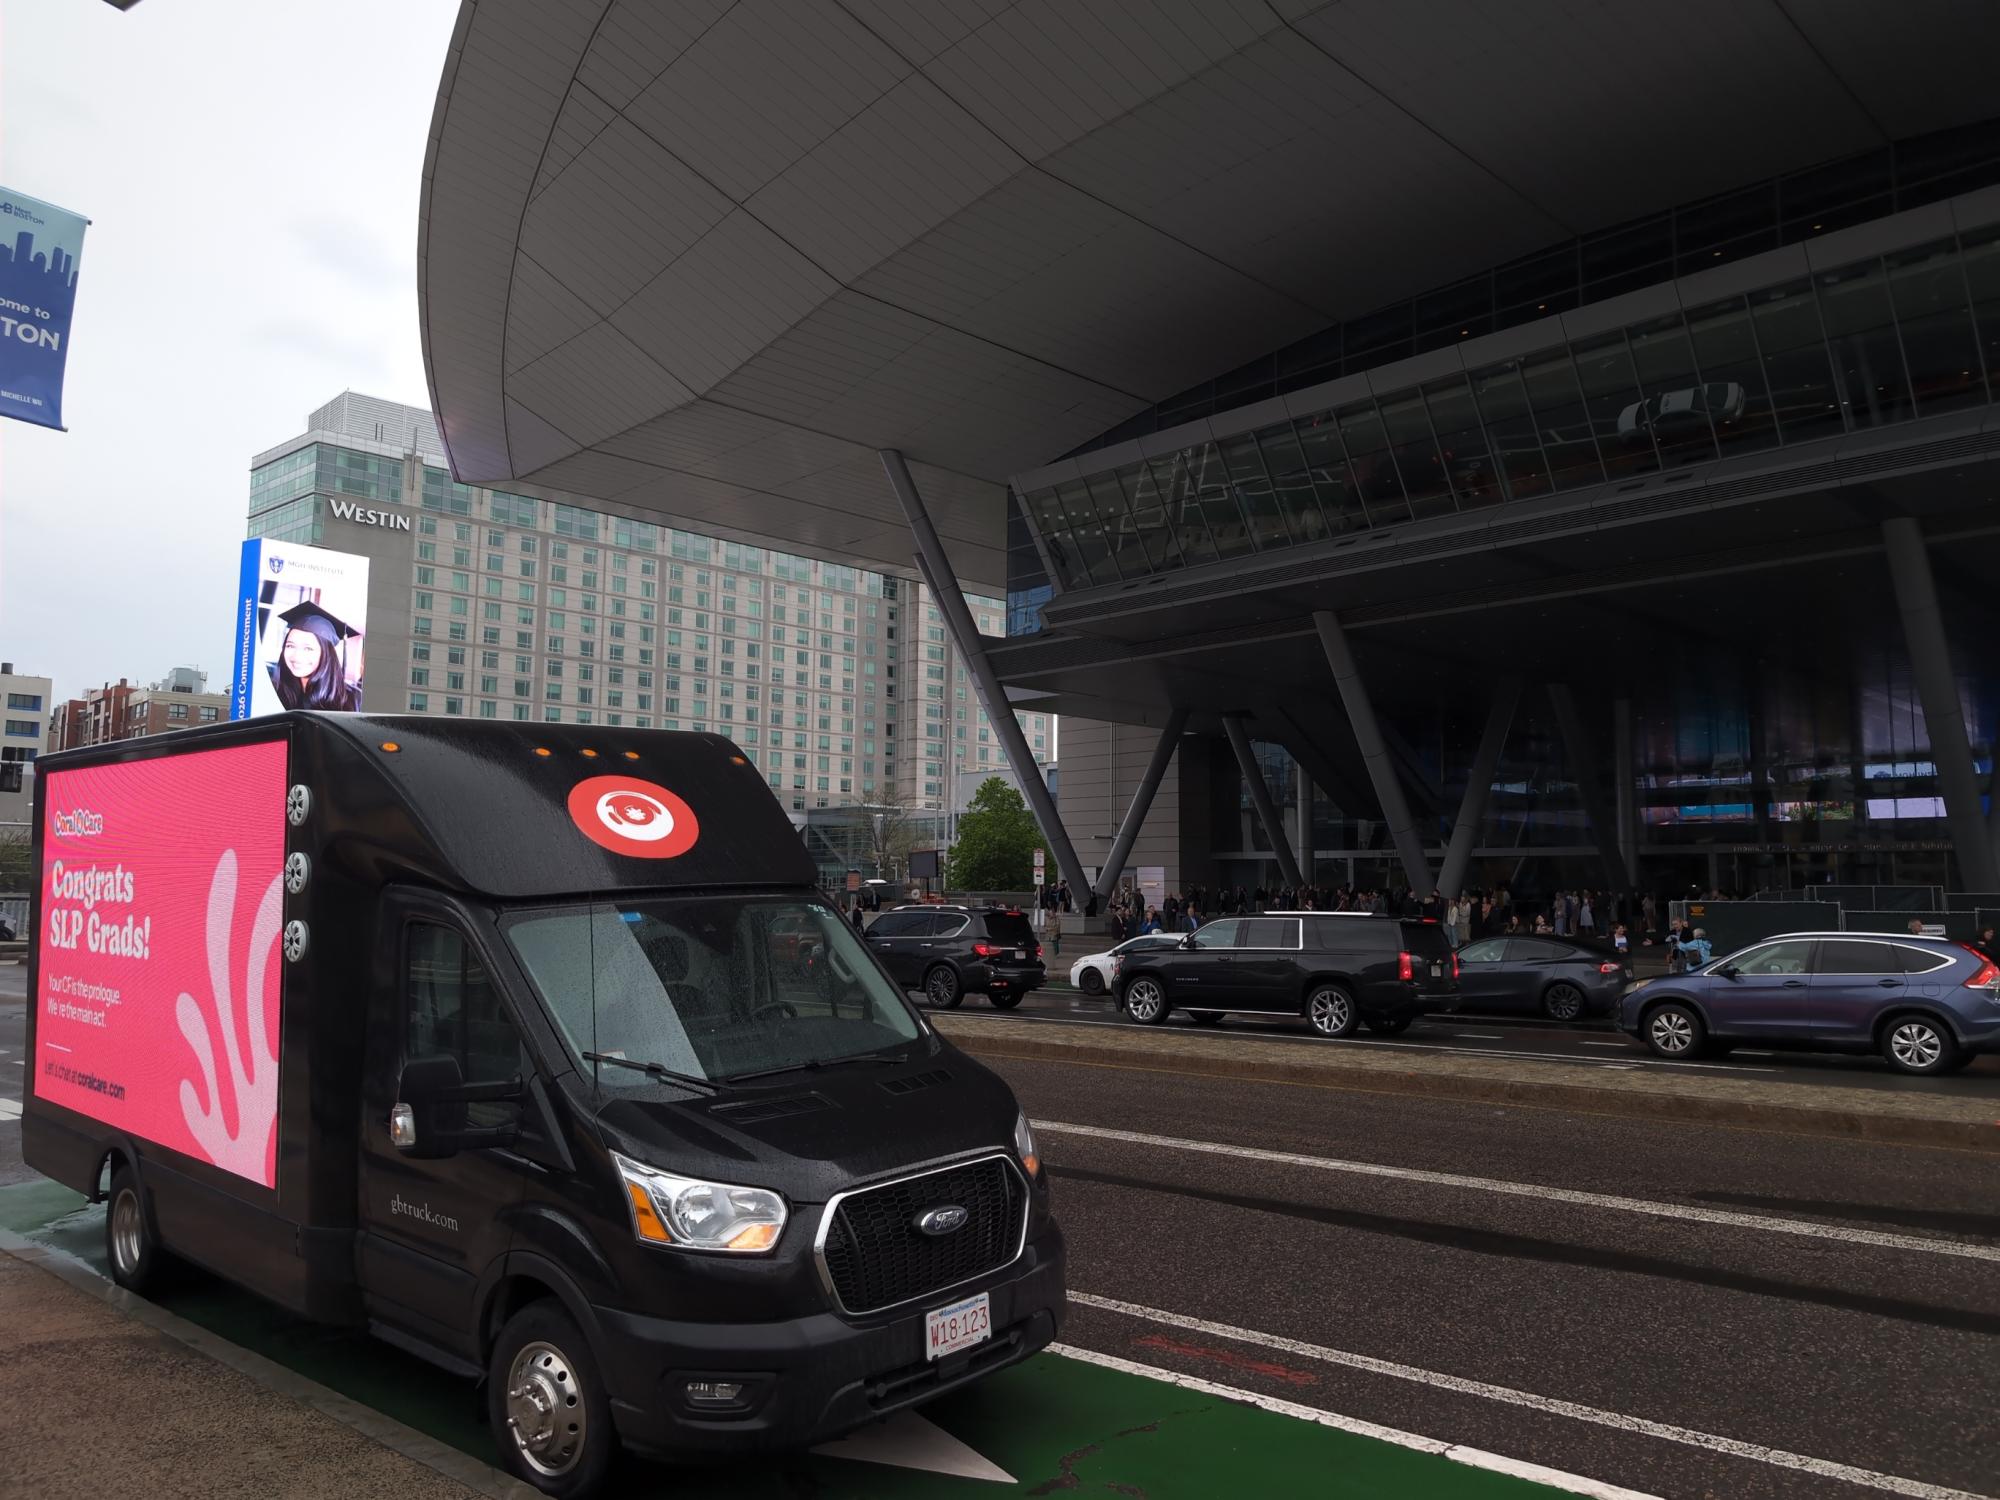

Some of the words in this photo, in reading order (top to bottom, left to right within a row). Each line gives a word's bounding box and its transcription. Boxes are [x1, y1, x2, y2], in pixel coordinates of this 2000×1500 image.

[14, 210, 45, 225] BOSTON
[34, 306, 51, 320] to
[238, 597, 252, 694] Commencement
[238, 696, 246, 719] 026
[55, 810, 76, 836] Coral
[83, 810, 103, 834] Care
[52, 860, 134, 909] Congrats
[50, 908, 83, 950] SLP
[87, 911, 151, 960] Grads!
[48, 972, 62, 992] Your
[62, 975, 72, 993] CF
[77, 976, 88, 998] the
[88, 982, 122, 1008] prologue.
[47, 996, 66, 1018] We're
[66, 1001, 77, 1020] the
[77, 1004, 93, 1024] main
[93, 1010, 107, 1027] act.
[78, 1071, 126, 1101] coralcare.com
[391, 1193, 459, 1232] gbtruck.com
[934, 1209, 961, 1231] Ford
